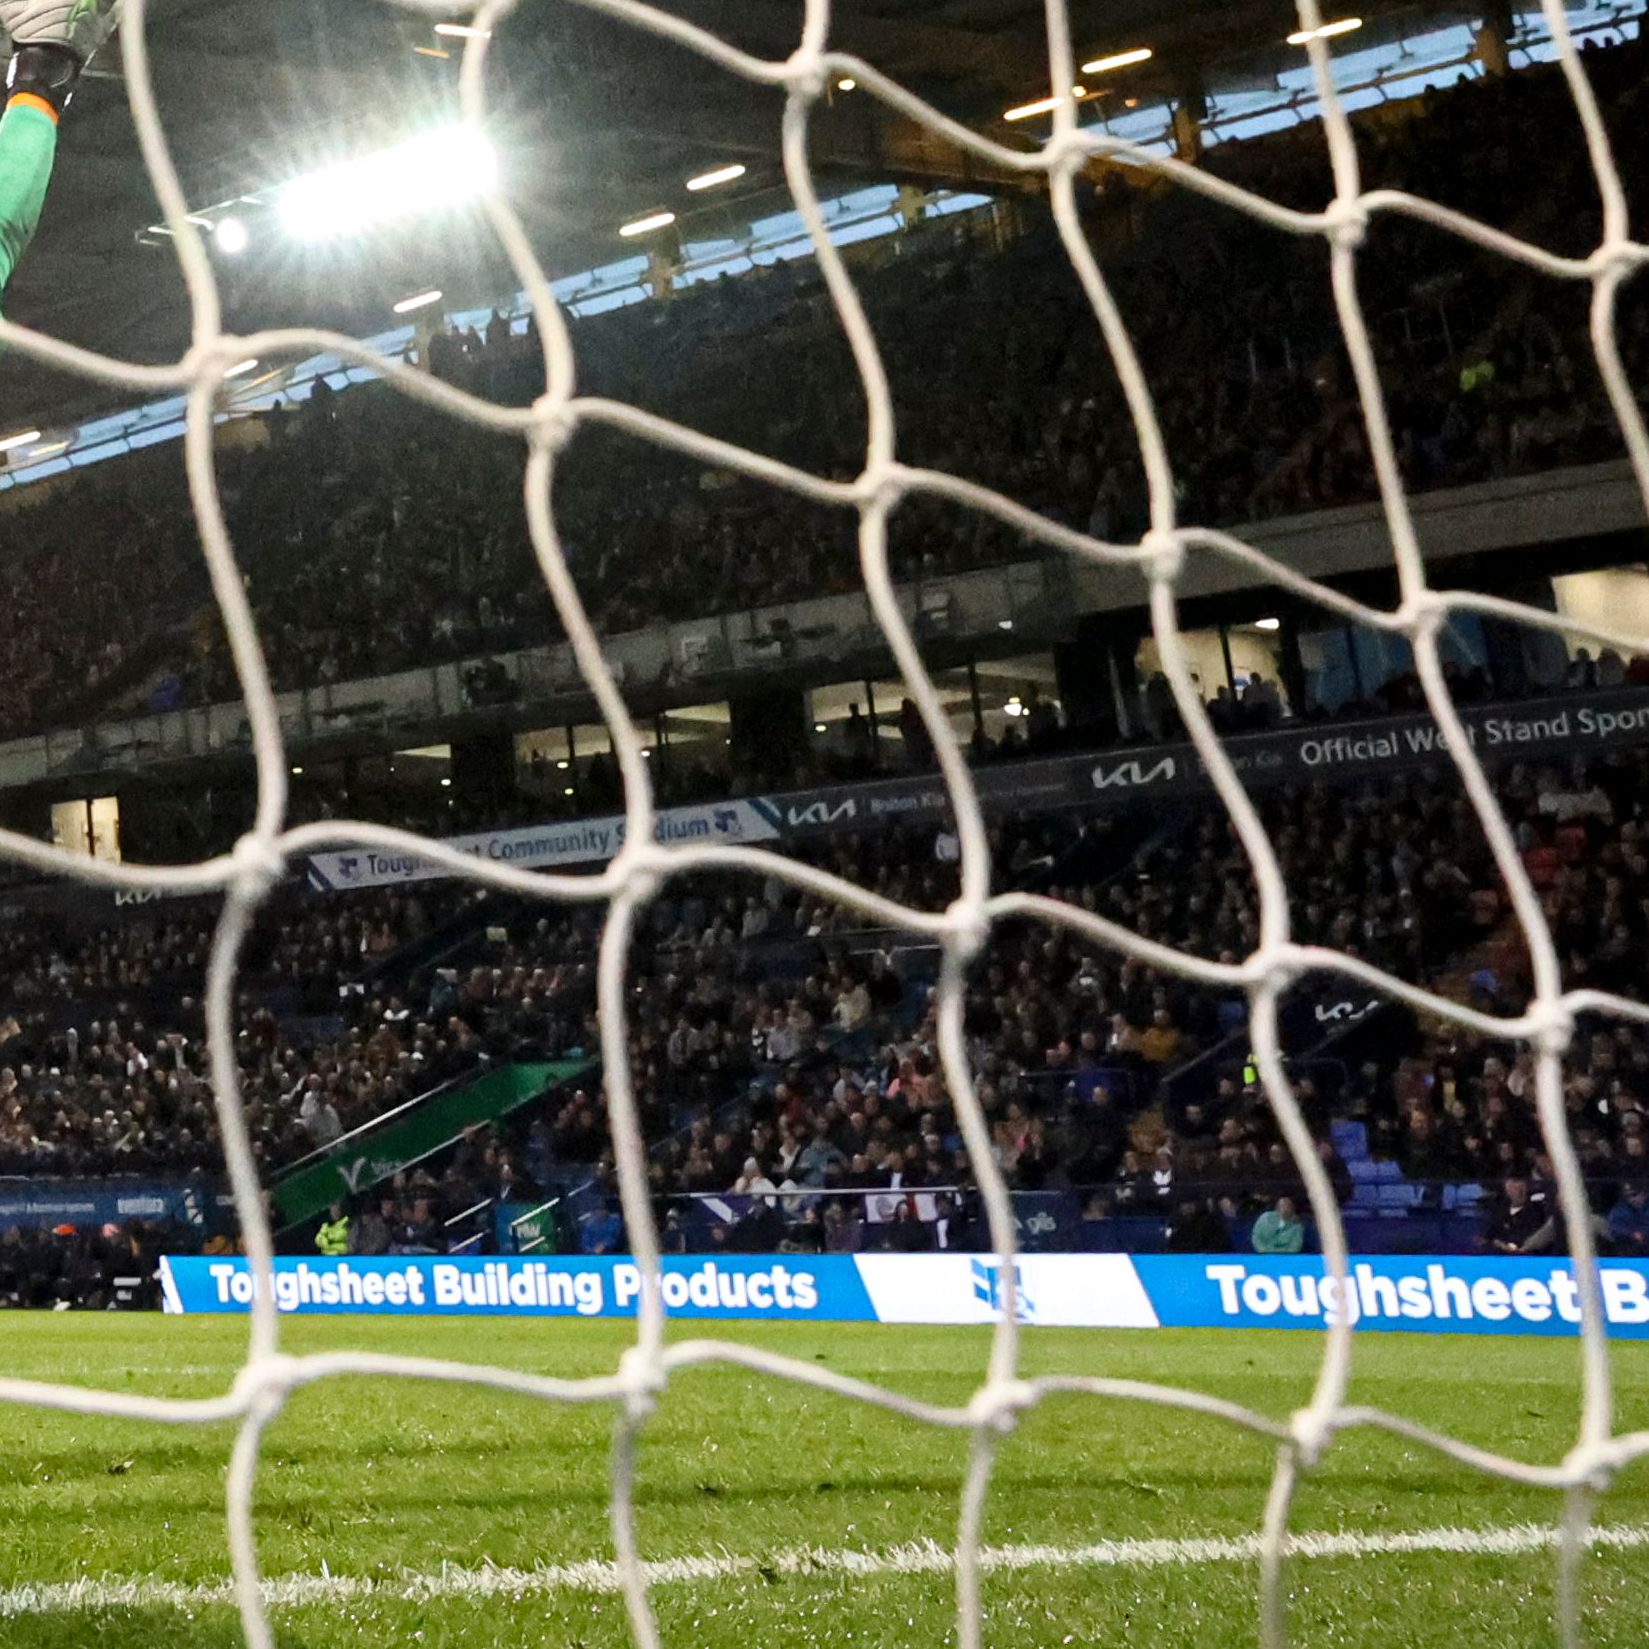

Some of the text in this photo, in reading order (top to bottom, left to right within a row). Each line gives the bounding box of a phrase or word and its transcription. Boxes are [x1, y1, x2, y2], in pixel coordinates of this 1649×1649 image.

[1301, 734, 1399, 766] Official
[1405, 722, 1476, 756] Wet
[1485, 709, 1570, 746] Stand
[489, 820, 612, 861] Community
[209, 1262, 817, 1316] Toghsheet Building Poducts
[1205, 1264, 1582, 1328] Toughsheet
